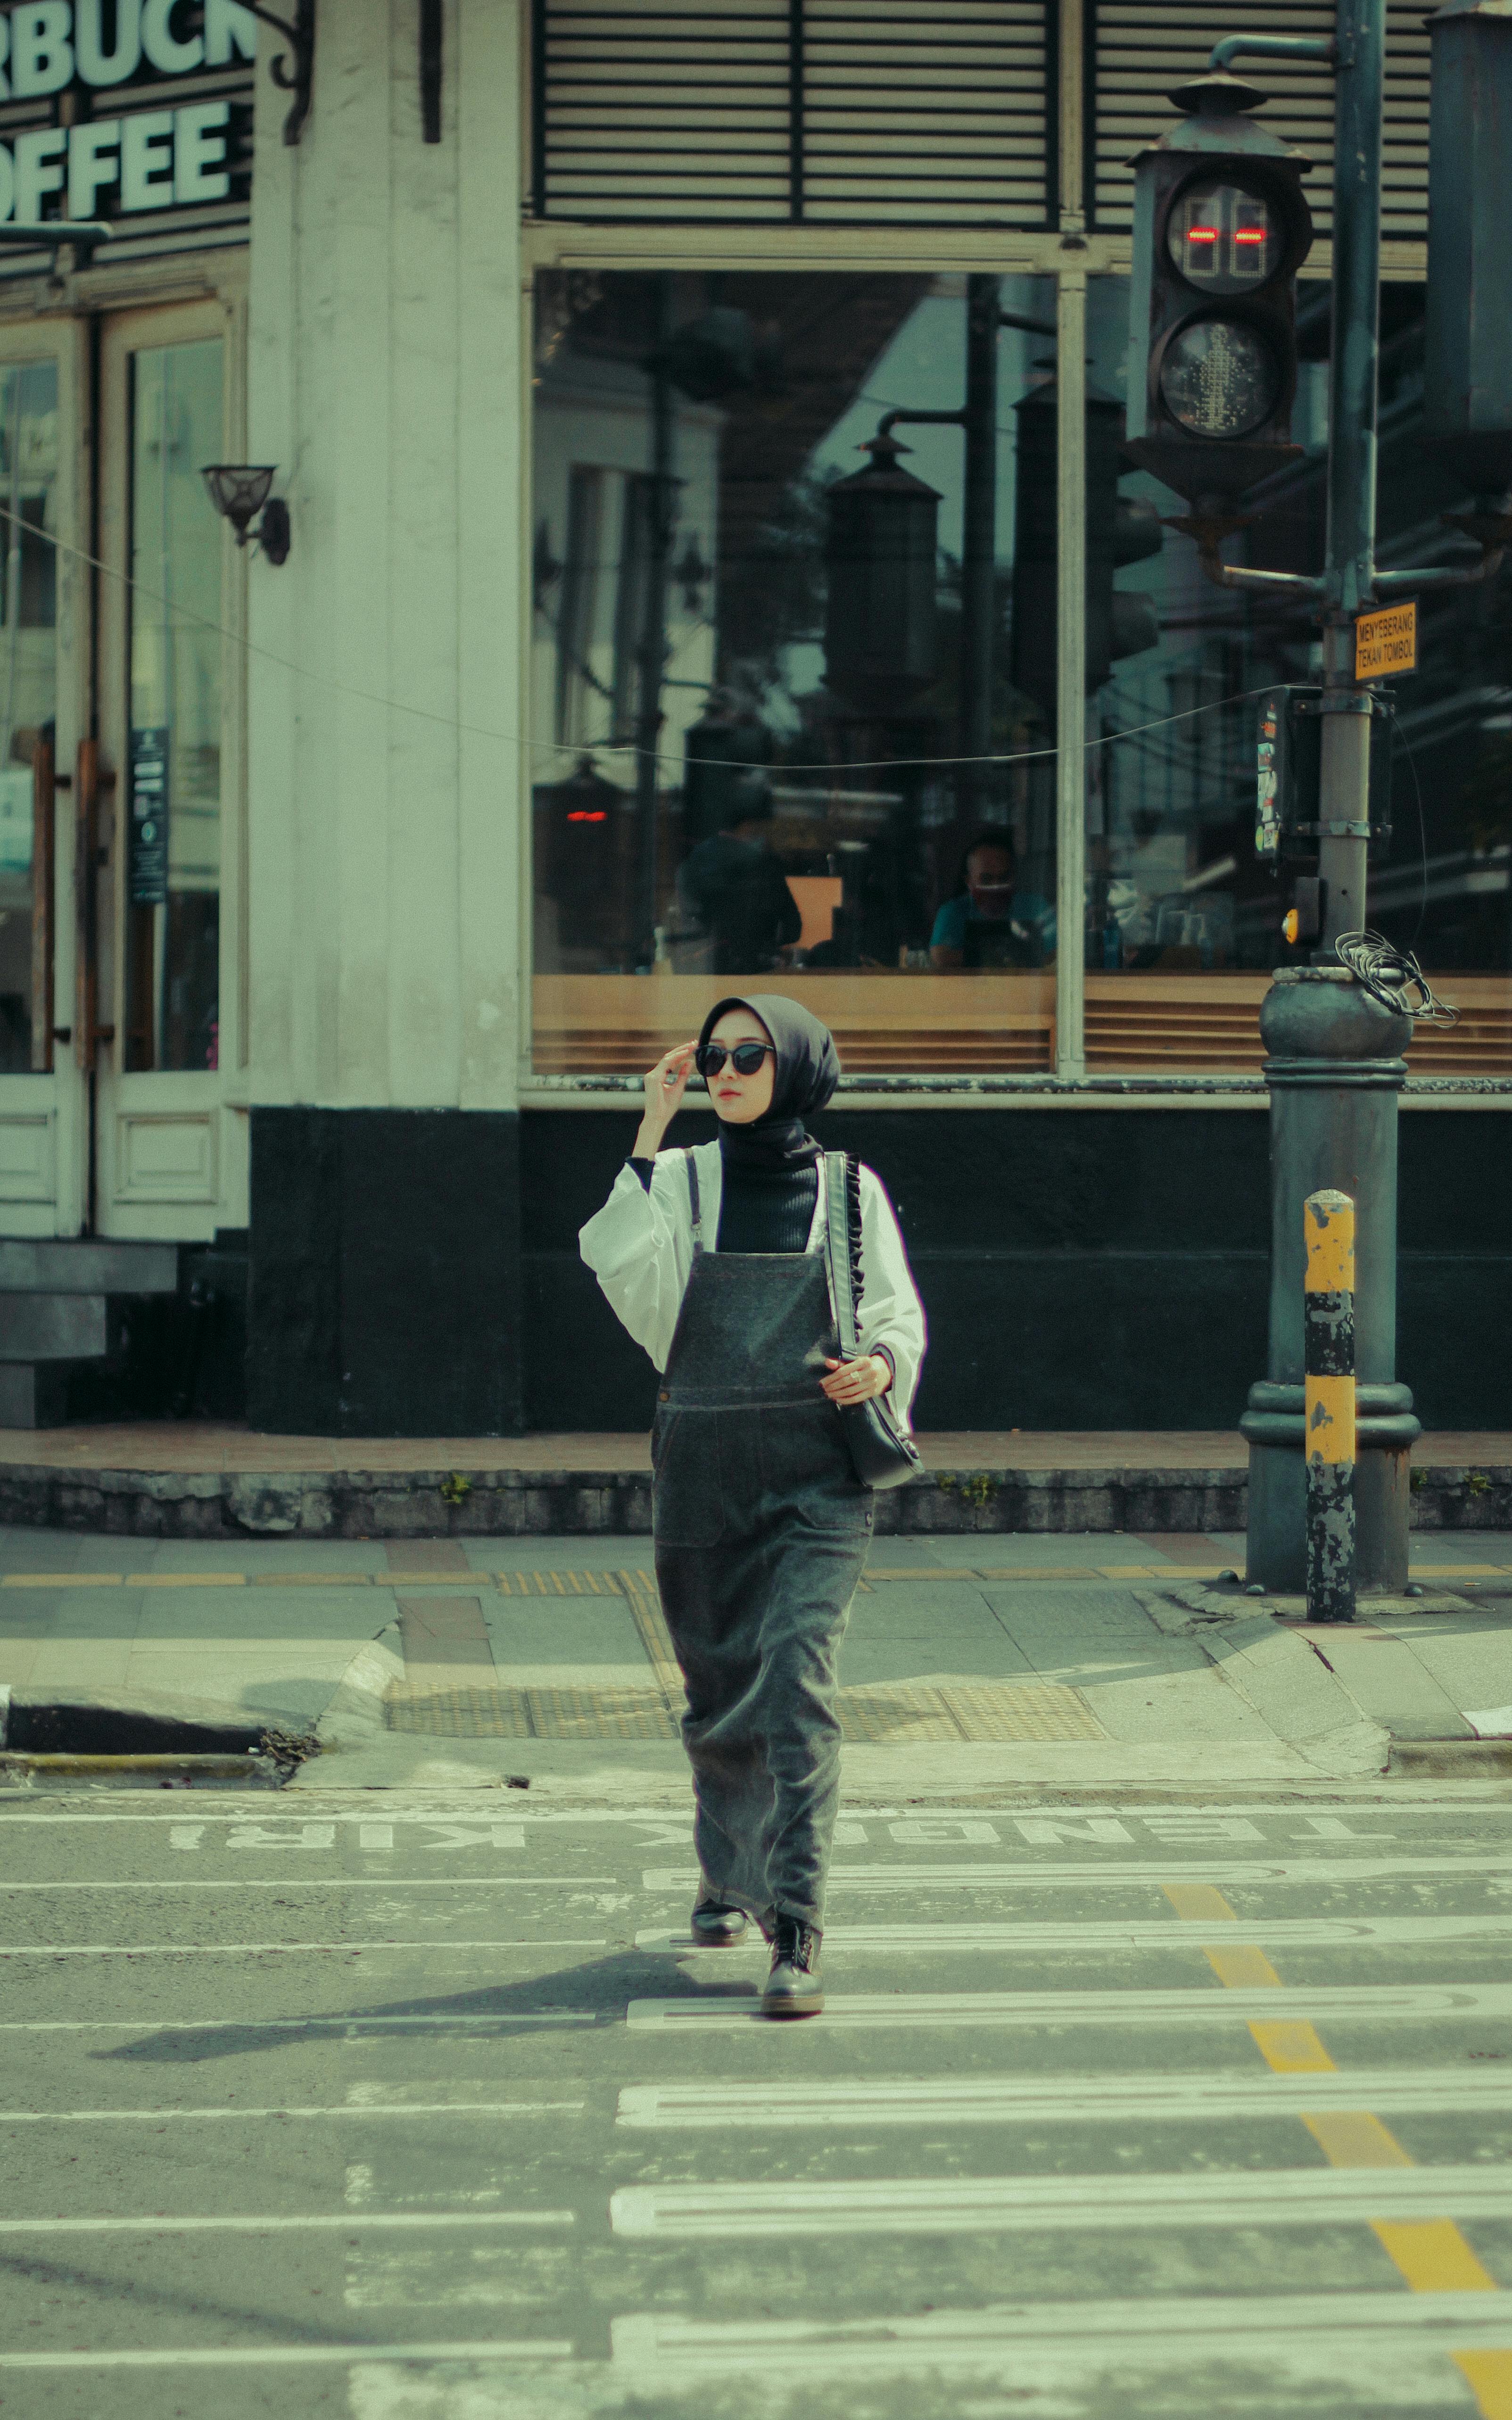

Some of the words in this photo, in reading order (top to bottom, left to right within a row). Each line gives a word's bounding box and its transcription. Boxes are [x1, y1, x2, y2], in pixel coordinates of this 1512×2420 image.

[0, 0, 257, 99] BUC
[0, 101, 230, 222] FFEE
[1360, 612, 1413, 642] MENYEBERANG
[1359, 647, 1381, 669] TEKAN
[1384, 638, 1413, 662] TOMBOL
[170, 1824, 525, 1849] KIRI
